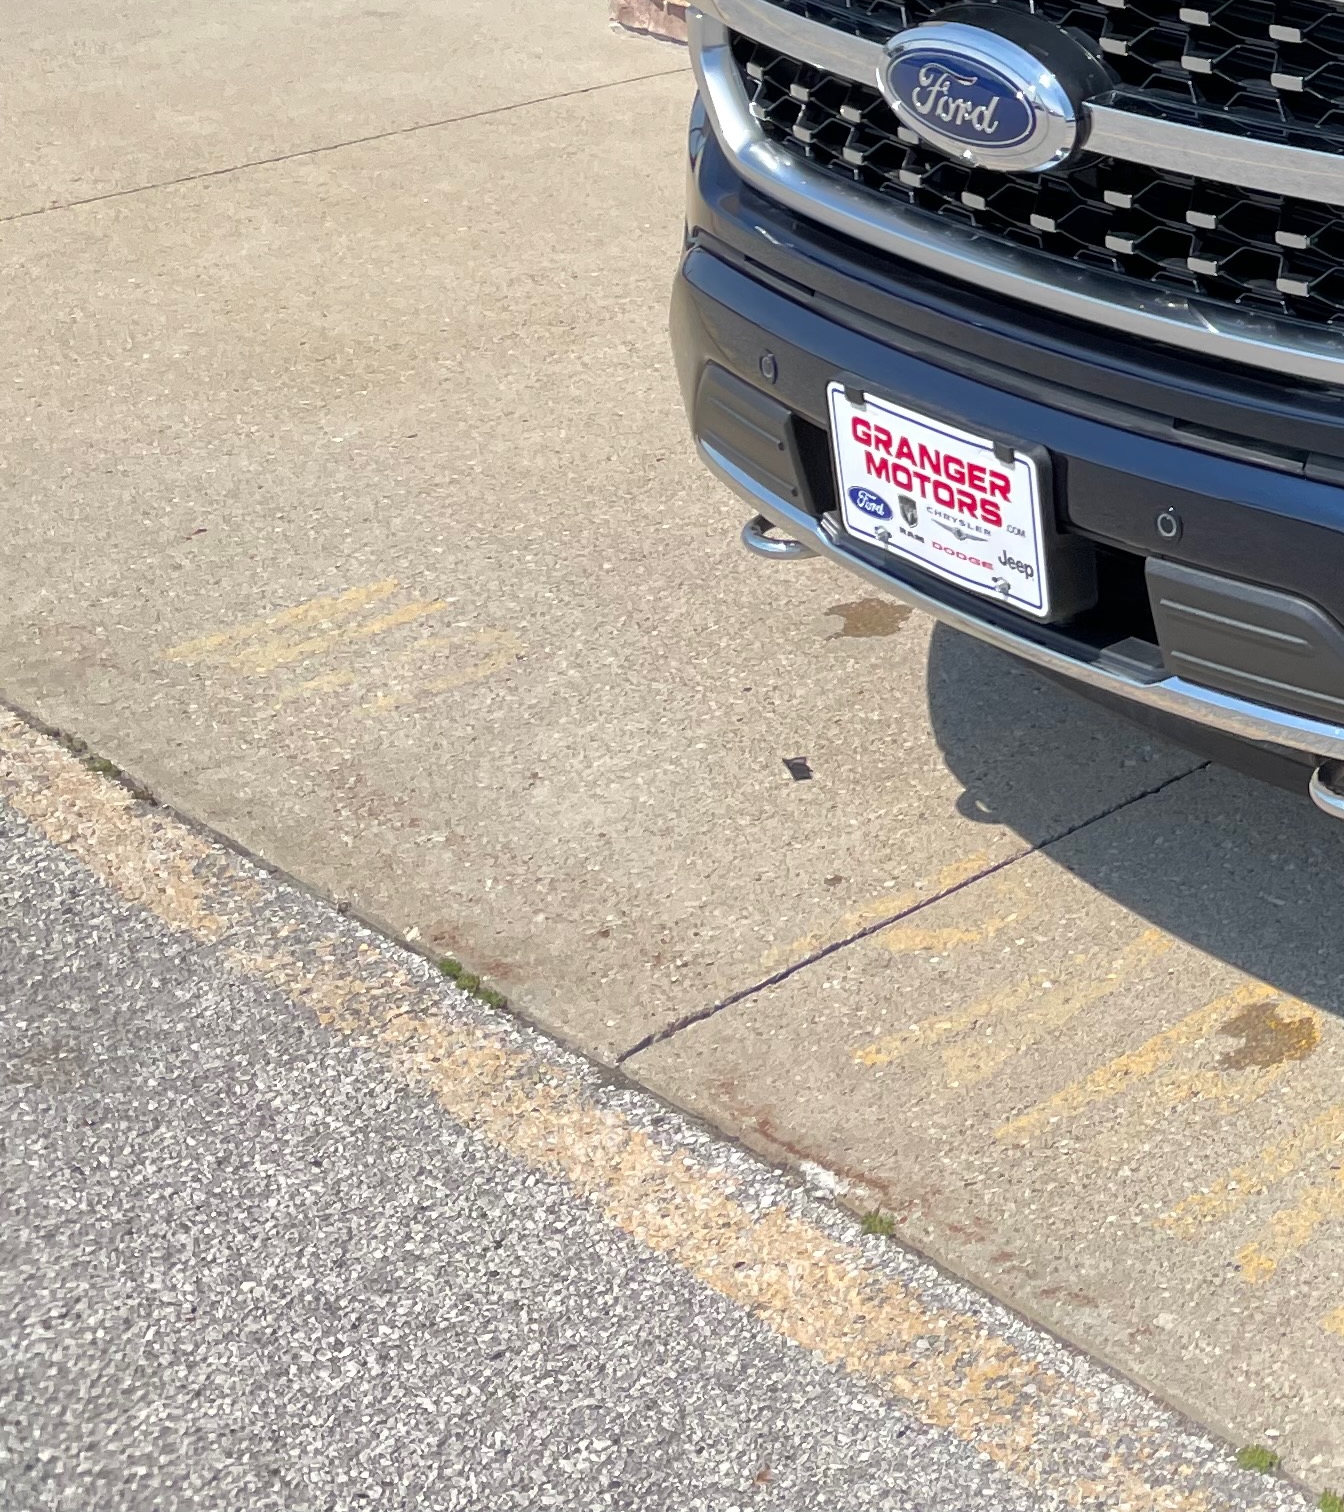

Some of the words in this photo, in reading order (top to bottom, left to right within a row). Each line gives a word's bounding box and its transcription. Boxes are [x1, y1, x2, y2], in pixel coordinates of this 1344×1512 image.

[911, 62, 1000, 134] Ford
[851, 415, 1012, 503] GRANGER
[855, 489, 885, 516] Ford
[864, 449, 1003, 528] MOTORS
[899, 526, 925, 544] RAM
[926, 506, 992, 537] CHRYSLER
[931, 541, 995, 571] DODGE
[998, 549, 1034, 580] Jeep
